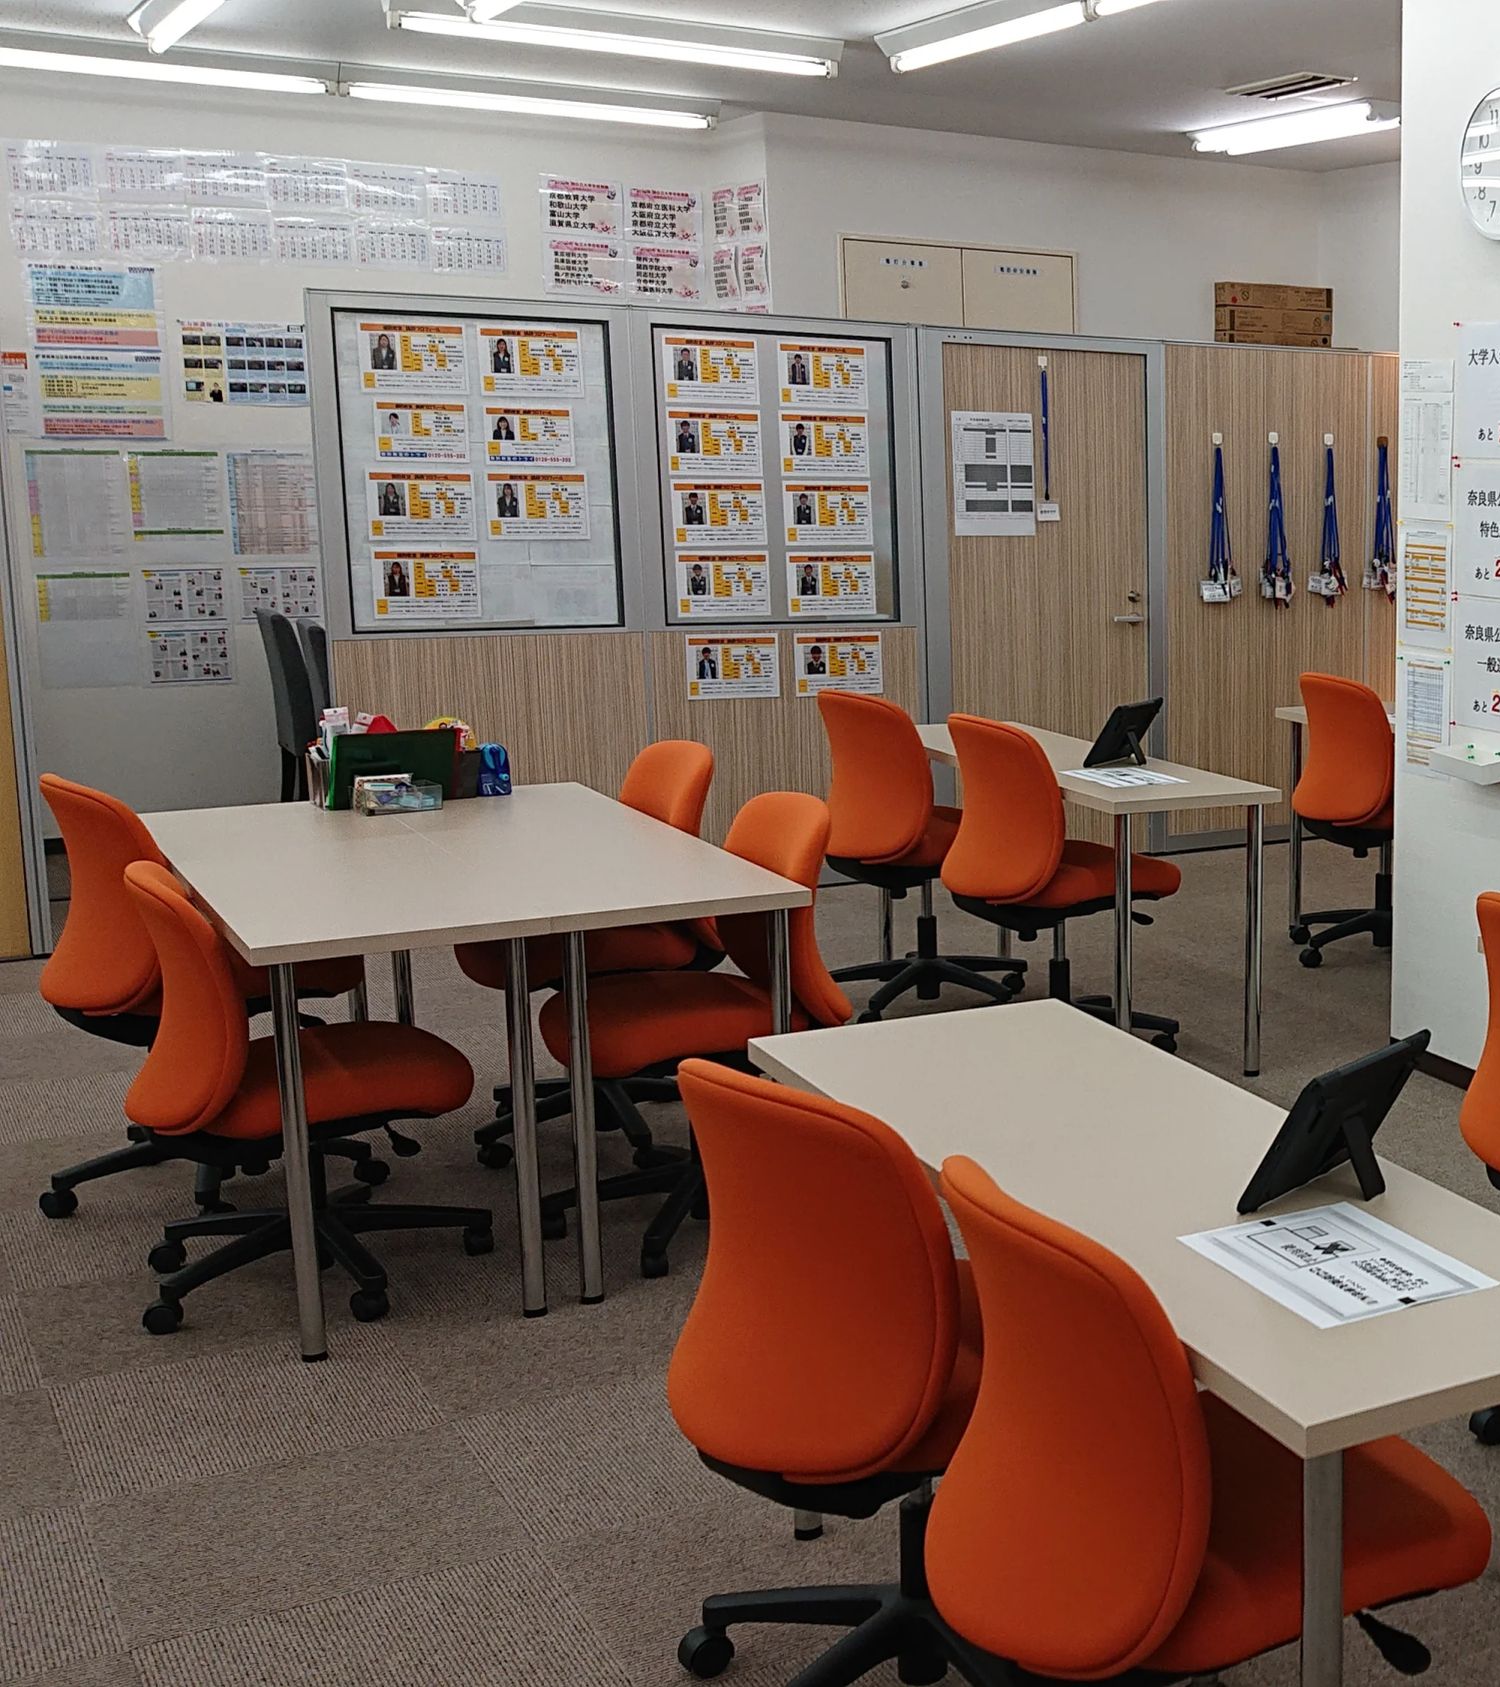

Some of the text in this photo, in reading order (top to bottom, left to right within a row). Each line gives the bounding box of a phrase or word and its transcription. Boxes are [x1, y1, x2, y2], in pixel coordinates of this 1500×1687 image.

[549, 200, 588, 211] 和歌山大学
[1489, 200, 1497, 218] 7
